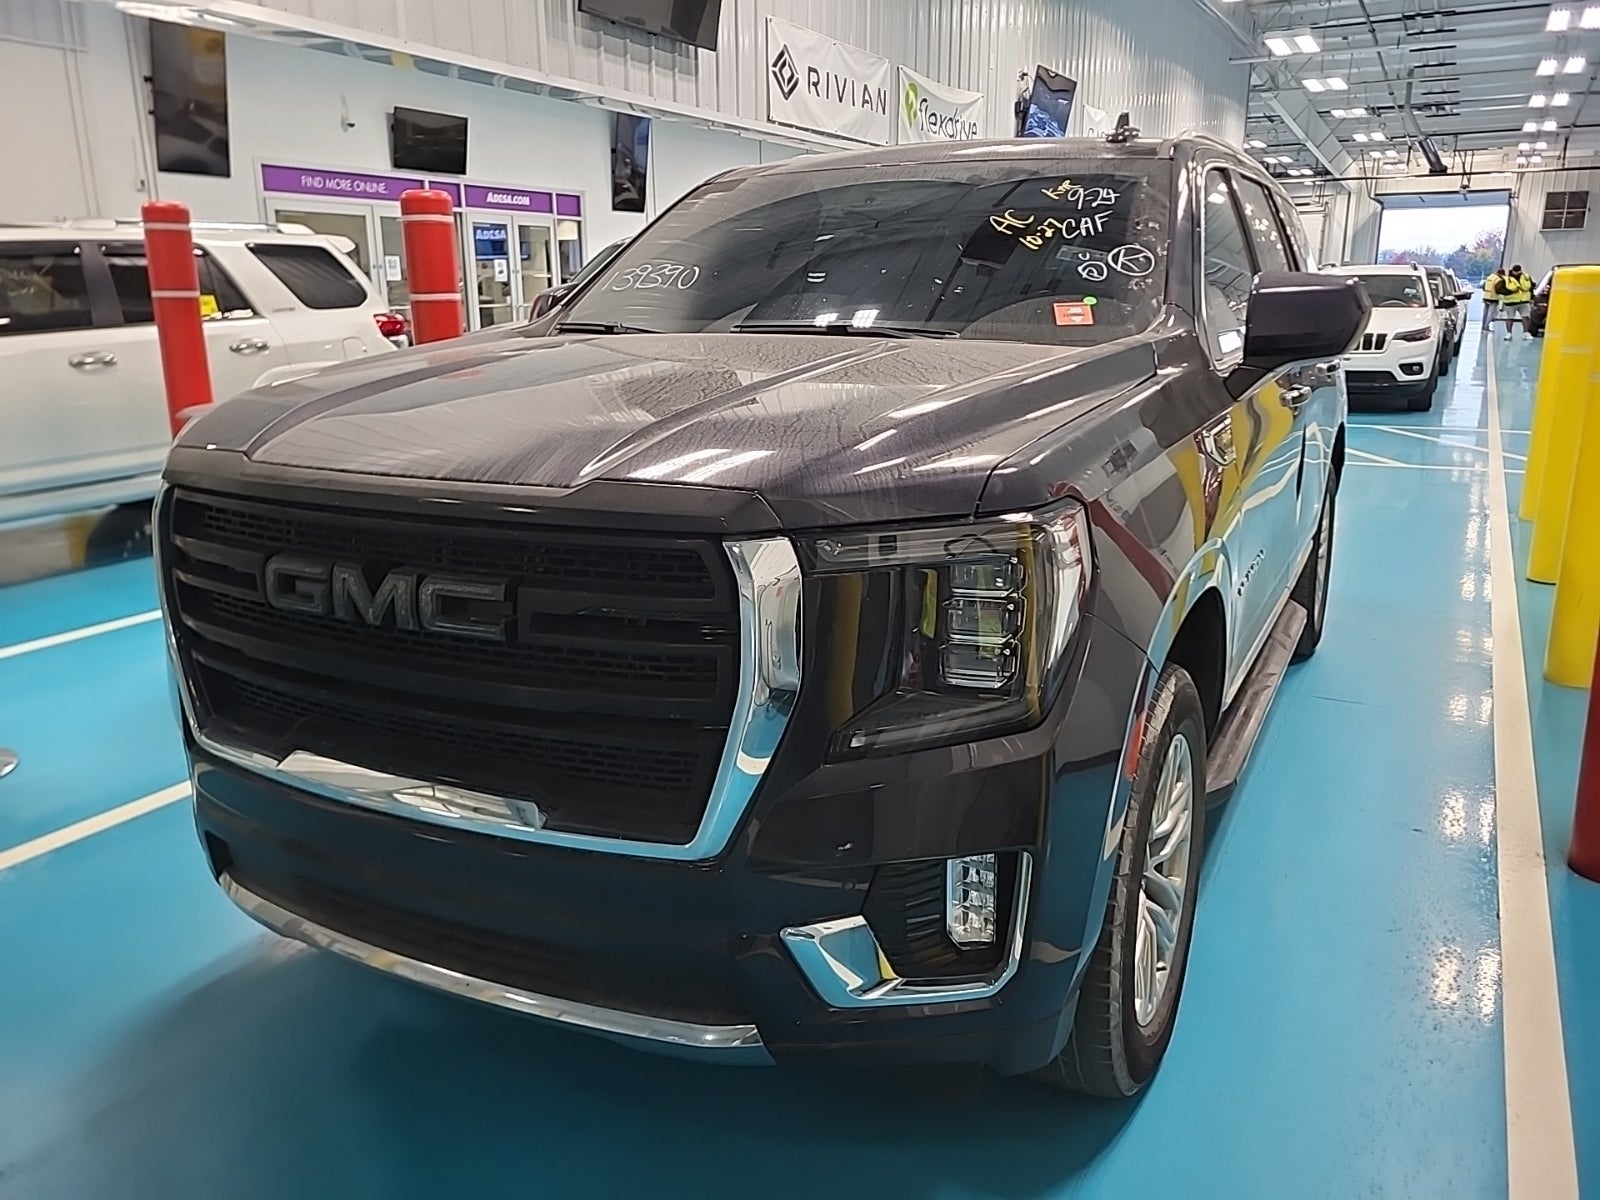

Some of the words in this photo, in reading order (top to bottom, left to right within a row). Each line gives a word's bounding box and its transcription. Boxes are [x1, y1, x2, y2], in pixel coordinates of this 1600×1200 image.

[808, 66, 888, 115] RIVIAN
[919, 98, 978, 140] flexdrive
[301, 175, 324, 188] FIND
[326, 178, 352, 191] MORE
[475, 229, 507, 240] ADESA
[1062, 210, 1114, 239] CAF
[266, 553, 508, 641] GMC
